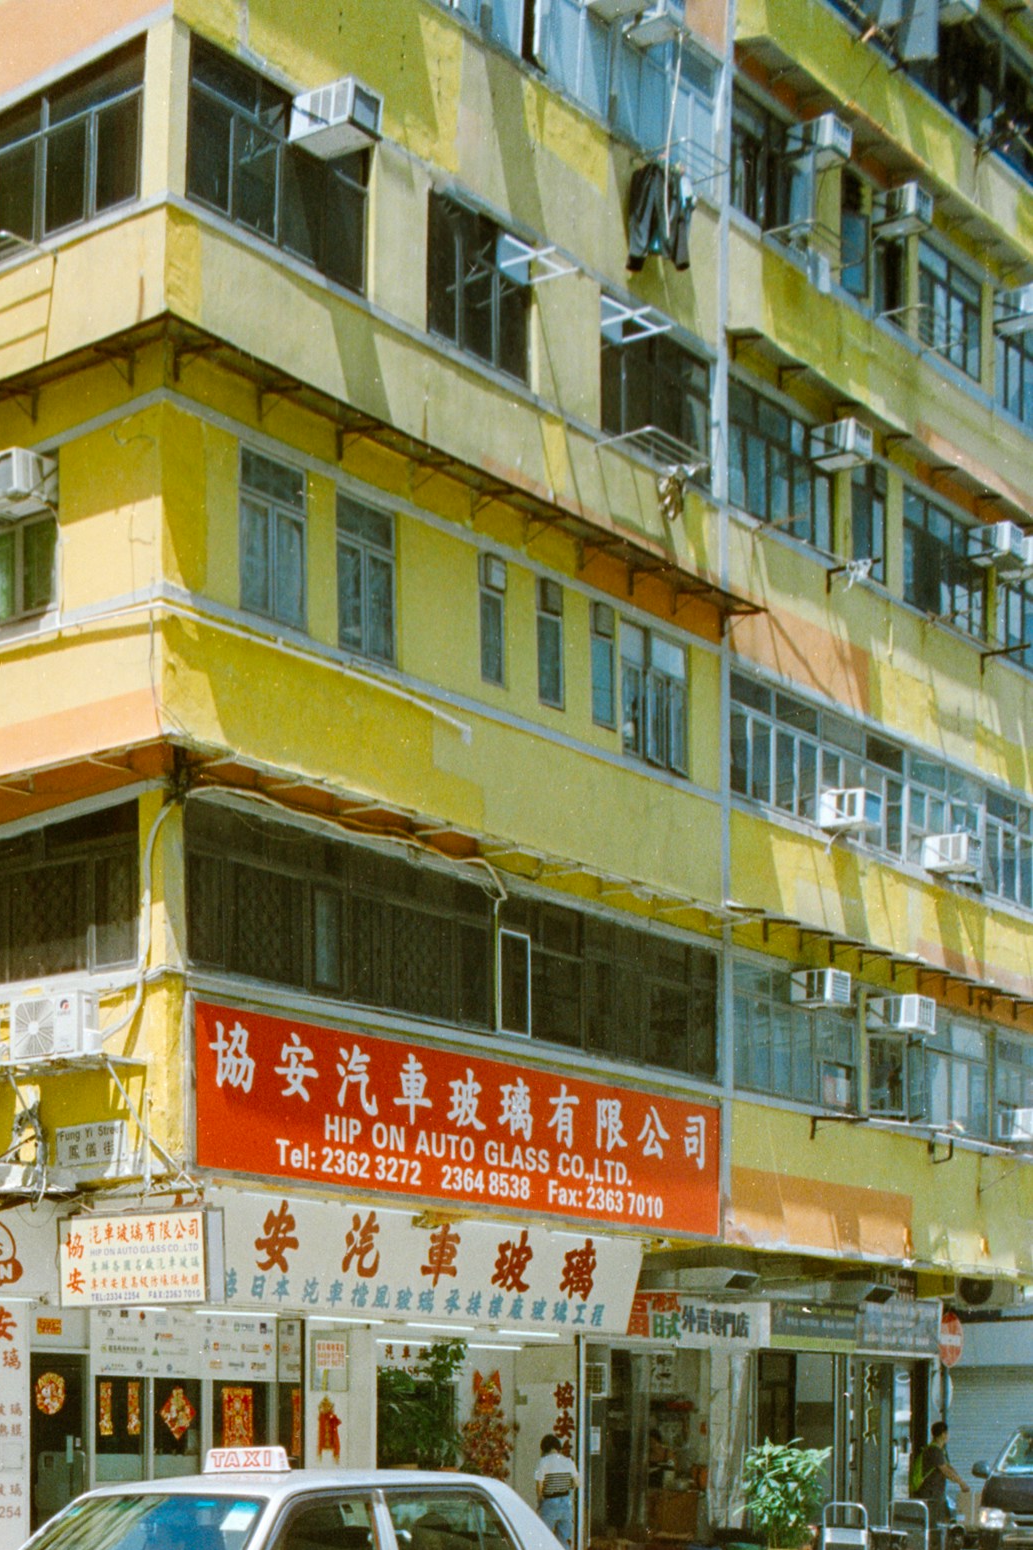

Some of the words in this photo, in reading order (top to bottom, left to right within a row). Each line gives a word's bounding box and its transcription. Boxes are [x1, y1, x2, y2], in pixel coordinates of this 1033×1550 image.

[208, 1020, 707, 1171] 協安汽車玻璃有限公司
[59, 1129, 81, 1143] Fung
[85, 1127, 93, 1139] Yi
[324, 1113, 362, 1145] HIP
[371, 1122, 406, 1152] ON
[415, 1130, 475, 1163] AUTO
[484, 1140, 551, 1174] GLASS
[275, 1138, 317, 1171] Tel:
[320, 1146, 371, 1179] 2362
[374, 1153, 422, 1186] 3272
[441, 1164, 485, 1194] 2364
[488, 1171, 531, 1201] 8538
[548, 1179, 583, 1208] Fax:
[586, 1186, 625, 1214] 2363
[628, 1192, 664, 1219] 7010
[90, 1217, 199, 1245] 汽車玻璃有限公司
[90, 1248, 101, 1257] HIP
[104, 1247, 116, 1257] ON
[117, 1246, 141, 1256] AUTO
[142, 1244, 167, 1254] GLASS
[173, 1190, 598, 1302] 安汽車玻璃
[64, 1231, 86, 1294] 協安
[681, 1304, 750, 1338] 外賣專門店
[211, 1450, 271, 1468] TAXI
